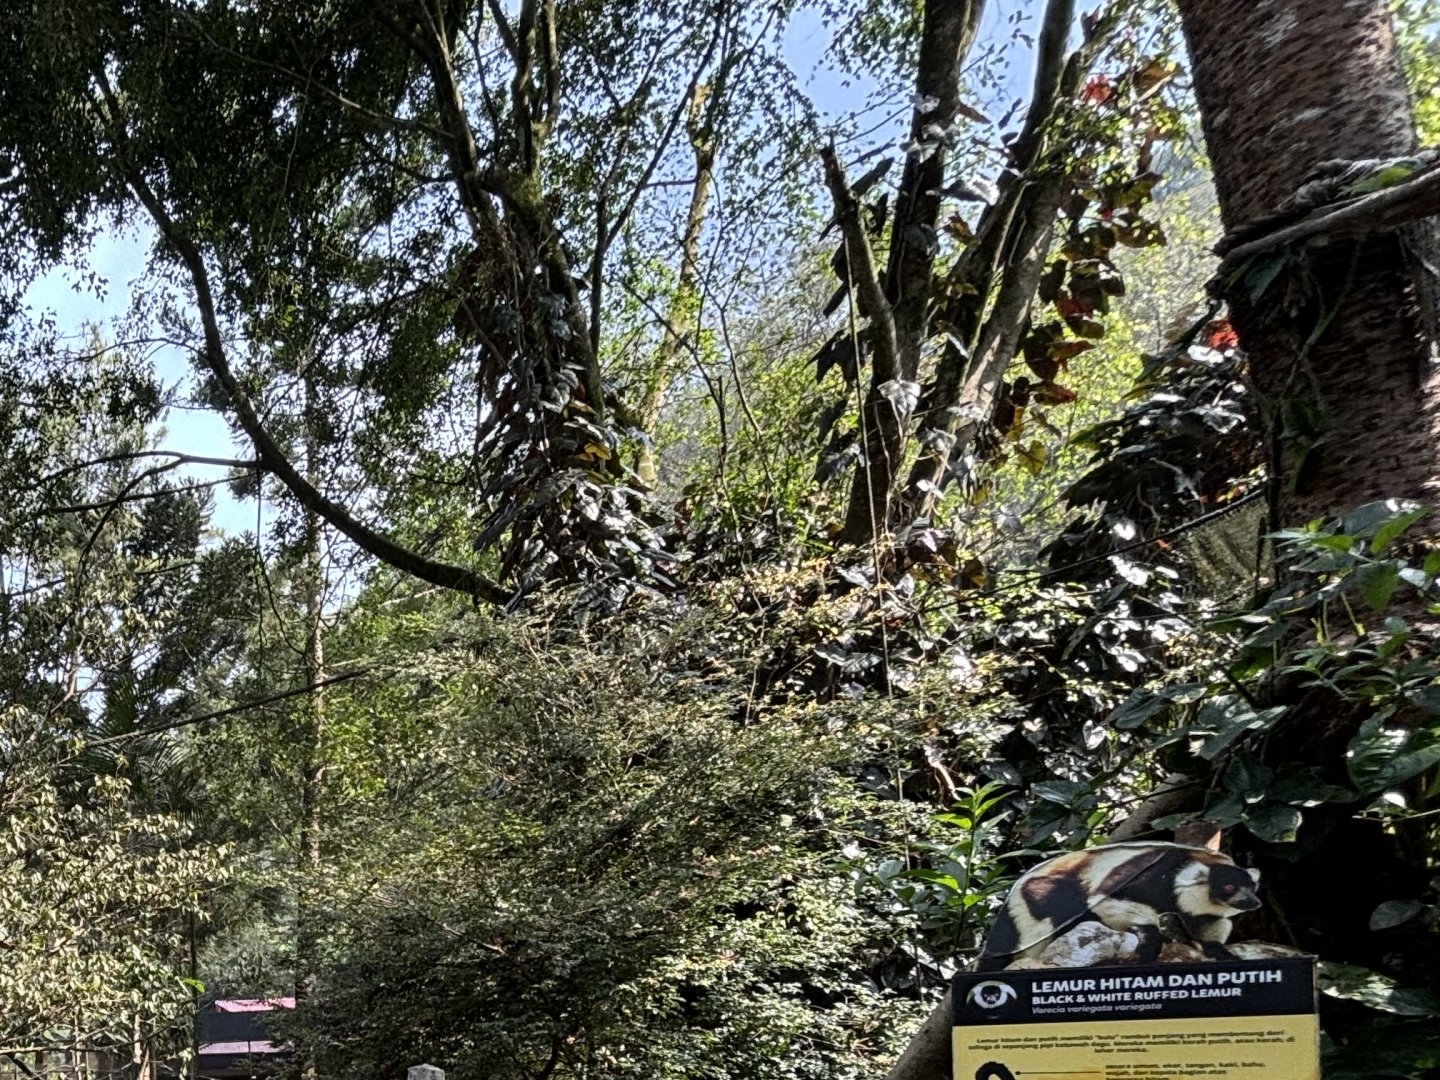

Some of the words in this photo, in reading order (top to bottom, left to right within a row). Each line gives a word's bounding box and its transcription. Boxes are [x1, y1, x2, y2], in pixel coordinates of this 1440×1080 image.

[1032, 980, 1095, 992] LEMUR
[1101, 977, 1163, 989] HITAM
[1169, 975, 1211, 987] DAN
[1218, 971, 1282, 984] PUTIH
[1032, 995, 1074, 1004] BLACK
[1088, 992, 1132, 1002] WHITE
[1135, 990, 1188, 1000] RUFFED
[1191, 988, 1242, 998] LEMUR
[1032, 1006, 1065, 1014] Varecia
[1067, 1005, 1112, 1013] variegata
[1115, 1002, 1162, 1011] variegata
